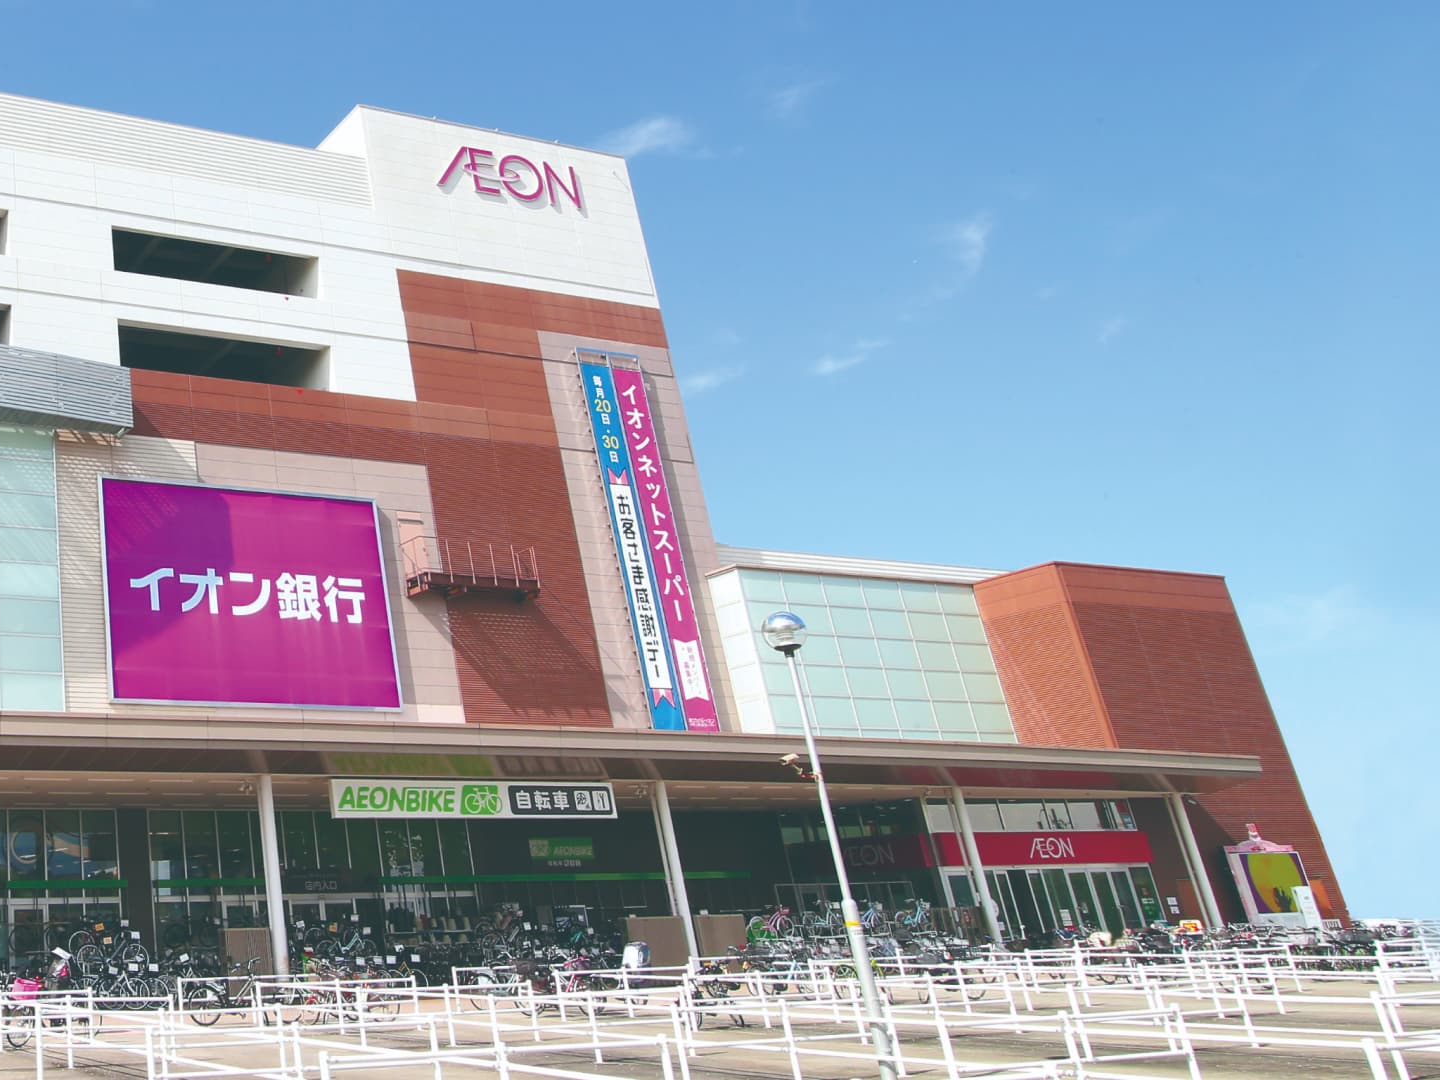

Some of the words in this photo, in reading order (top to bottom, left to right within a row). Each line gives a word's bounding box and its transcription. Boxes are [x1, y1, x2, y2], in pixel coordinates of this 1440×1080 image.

[622, 384, 685, 622] イオンネットスーパー
[129, 567, 366, 624] イオン銀行
[337, 785, 456, 813] AEONBIKE
[515, 789, 570, 811] 自転車
